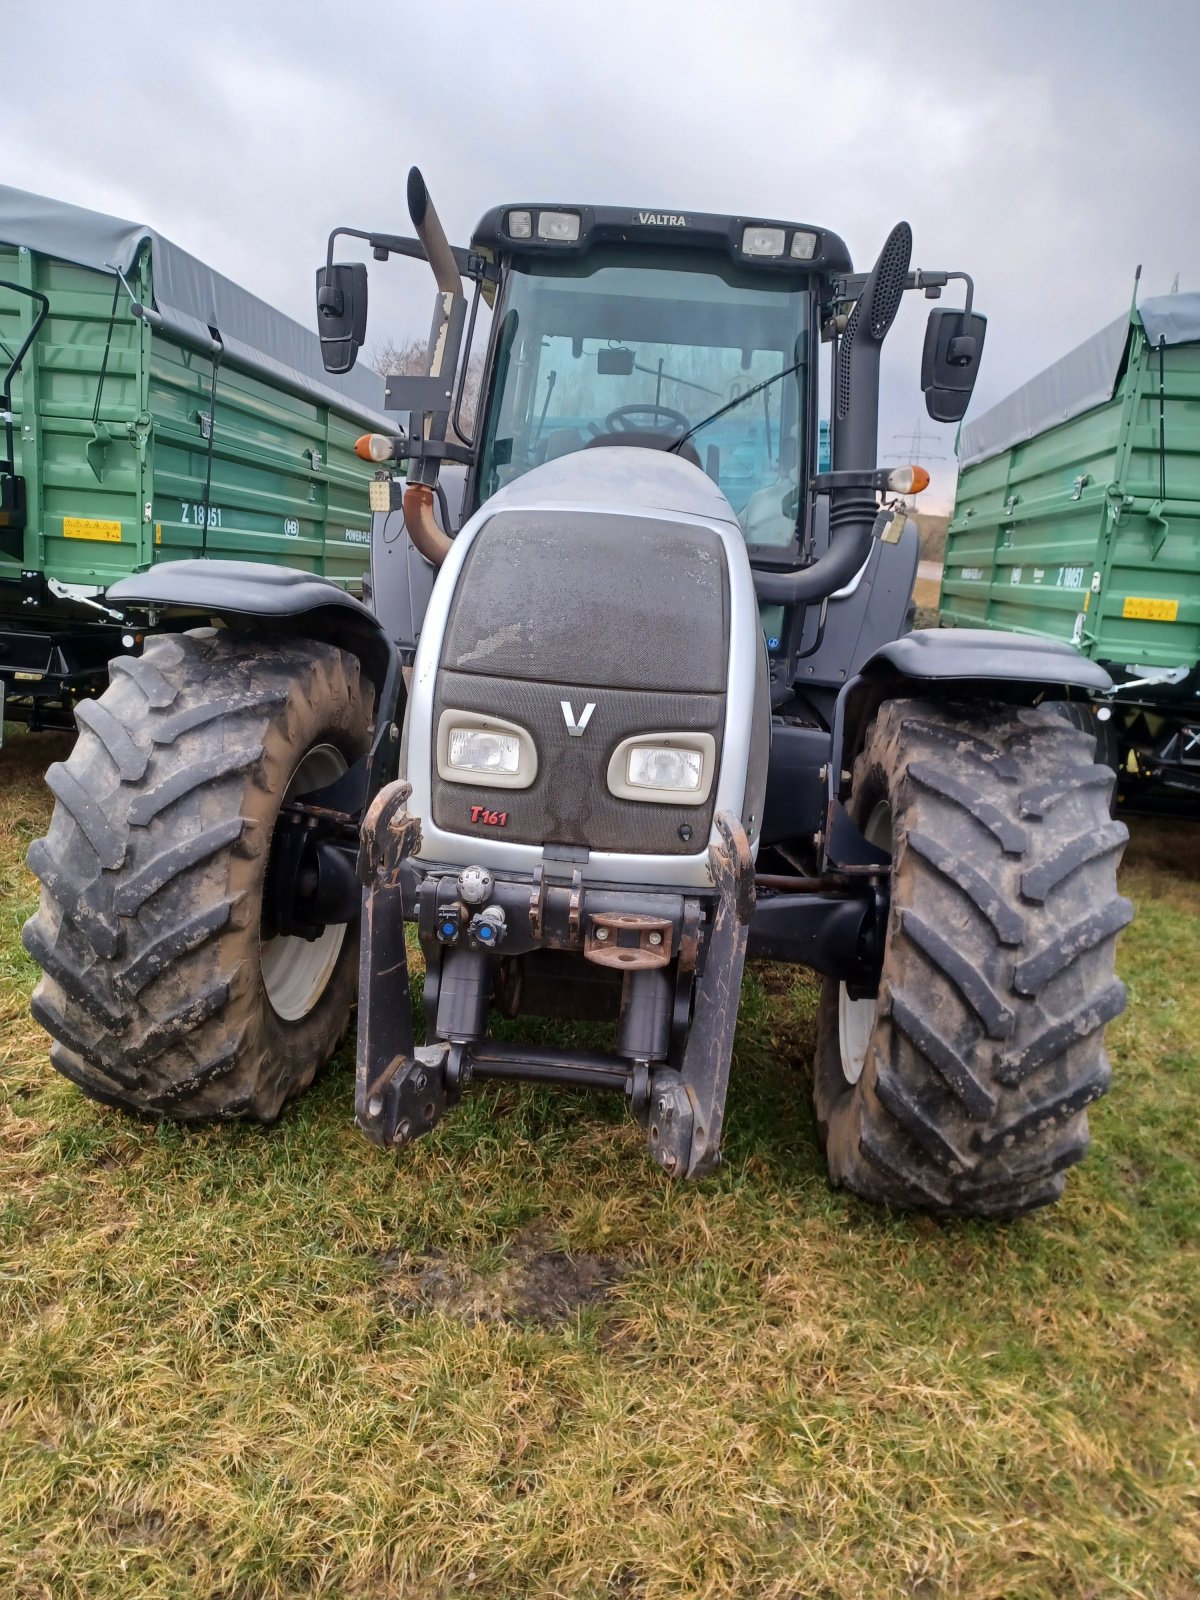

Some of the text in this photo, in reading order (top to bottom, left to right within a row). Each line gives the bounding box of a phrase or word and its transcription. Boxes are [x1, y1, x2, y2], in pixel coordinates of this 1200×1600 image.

[639, 212, 686, 226] VALTRA
[181, 503, 189, 523] Z
[470, 805, 508, 826] T161
